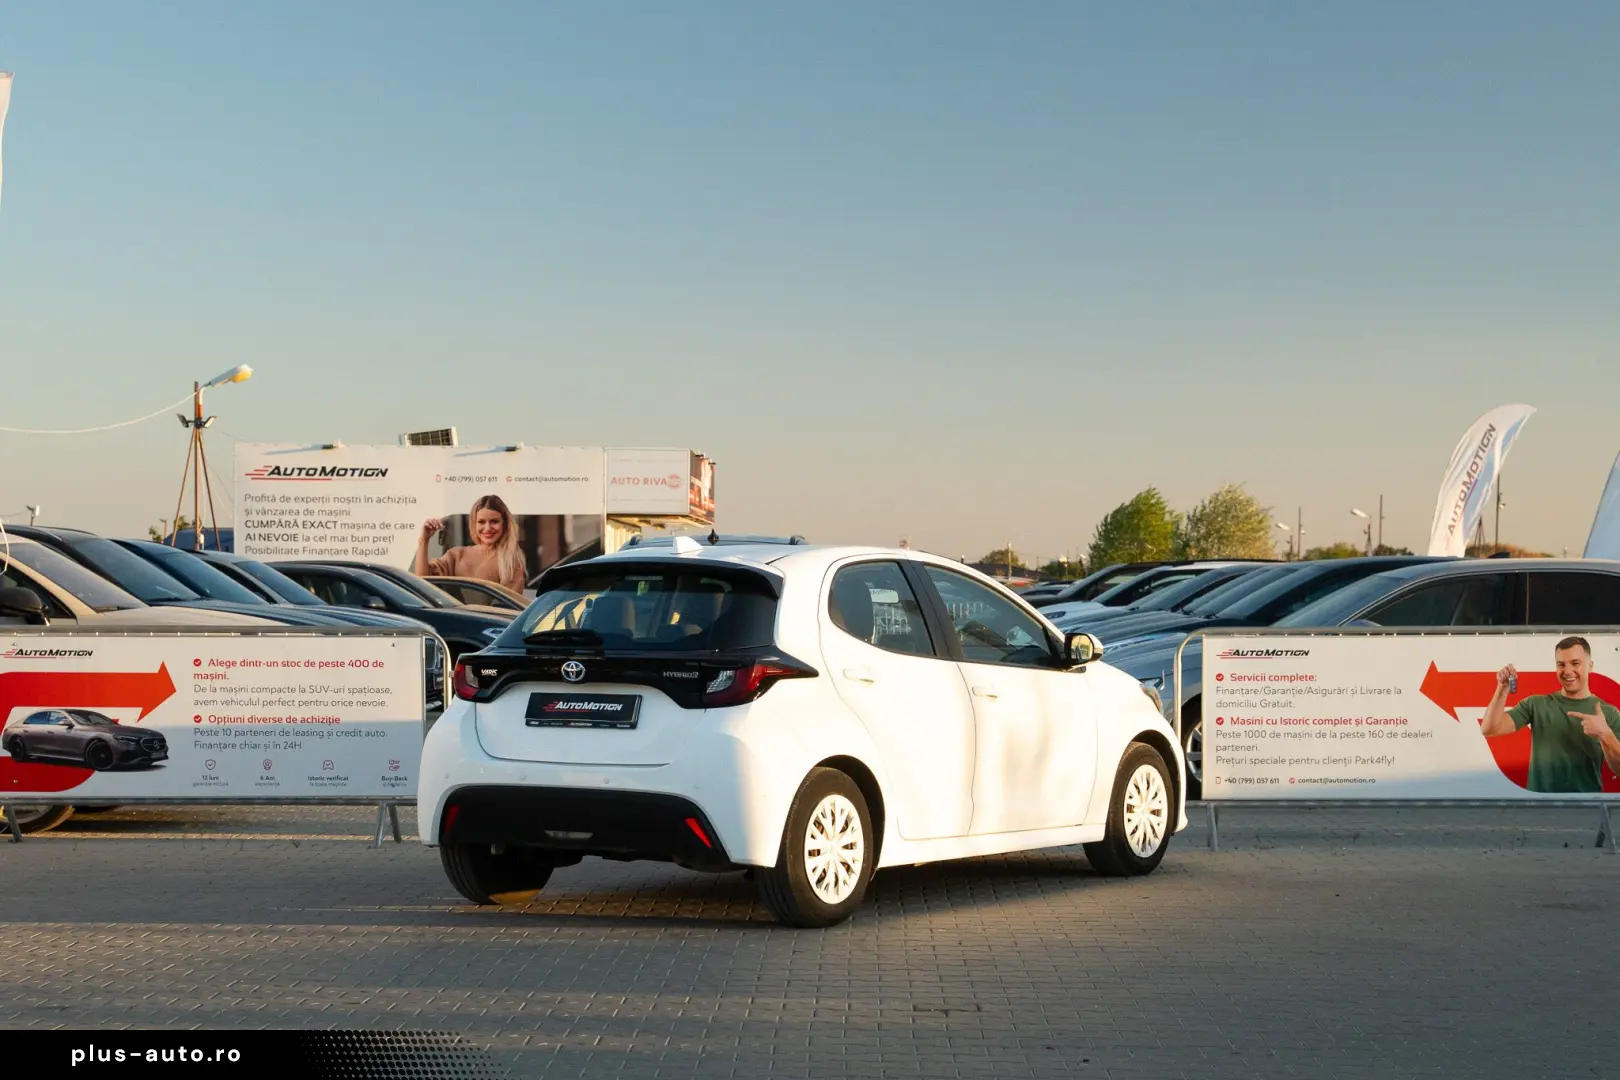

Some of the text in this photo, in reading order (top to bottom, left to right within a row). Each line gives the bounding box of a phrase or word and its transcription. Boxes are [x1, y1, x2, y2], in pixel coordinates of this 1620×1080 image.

[610, 476, 668, 486] AUTO RIVA
[279, 495, 292, 504] de
[303, 508, 314, 516] de
[245, 519, 300, 528] CUMPĂRĂ
[302, 520, 338, 529] EXACT
[379, 521, 392, 530] de
[245, 533, 256, 542] AI
[258, 533, 299, 542] NEVOIE
[302, 534, 310, 542] la
[313, 534, 327, 542] cel
[330, 534, 348, 542] mai
[351, 534, 370, 542] bun
[245, 546, 300, 555] Posibilitate
[302, 547, 349, 557] Finanțare
[208, 659, 237, 668] Alege
[240, 659, 279, 668] dintr-un
[282, 660, 302, 668] stoc
[304, 660, 316, 668] de
[318, 661, 346, 669] peste
[372, 660, 384, 668] de
[1230, 673, 1317, 684] Servicii complete:
[194, 684, 208, 693] De
[210, 684, 218, 693] la
[251, 686, 296, 696] compacte
[298, 685, 306, 694] la
[309, 685, 345, 694] SUV-uri
[1360, 686, 1392, 695] Livrare
[1394, 686, 1402, 695] la
[220, 698, 260, 706] vehiculul
[262, 698, 296, 709] perfect
[298, 700, 328, 709] pentru
[331, 699, 354, 707] orice
[356, 699, 388, 707] nevoie.
[1216, 700, 1296, 708] domiciliu Gratuit.
[208, 716, 340, 726] Opțiuni diverse de achiziție
[1280, 717, 1310, 726] Istoric
[1312, 717, 1352, 728] complet
[1366, 717, 1408, 728] Garanție
[194, 728, 220, 737] Peste
[222, 728, 232, 737] 10
[234, 729, 276, 739] parteneri
[278, 728, 290, 737] de
[292, 728, 324, 740] leasing
[336, 728, 362, 738] credit
[1216, 730, 1242, 739] Peste
[1244, 730, 1267, 739] 1000
[1269, 730, 1282, 739] de
[1315, 730, 1328, 739] de
[1330, 730, 1338, 739] la
[1340, 732, 1366, 740] peste
[1368, 730, 1384, 739] 160
[1386, 730, 1398, 739] de
[1400, 730, 1434, 739] dealeri
[194, 741, 237, 751] Finanțare
[239, 741, 260, 750] chiar
[283, 742, 302, 750] 24H
[1216, 744, 1260, 753] parteneri.
[1216, 756, 1248, 766] Prețuri
[1250, 756, 1287, 766] speciale
[1289, 758, 1320, 766] pentru
[1355, 756, 1396, 766] Park4fly!
[1238, 776, 1255, 784] (799)
[1298, 776, 1376, 784] contact@automotion.ro
